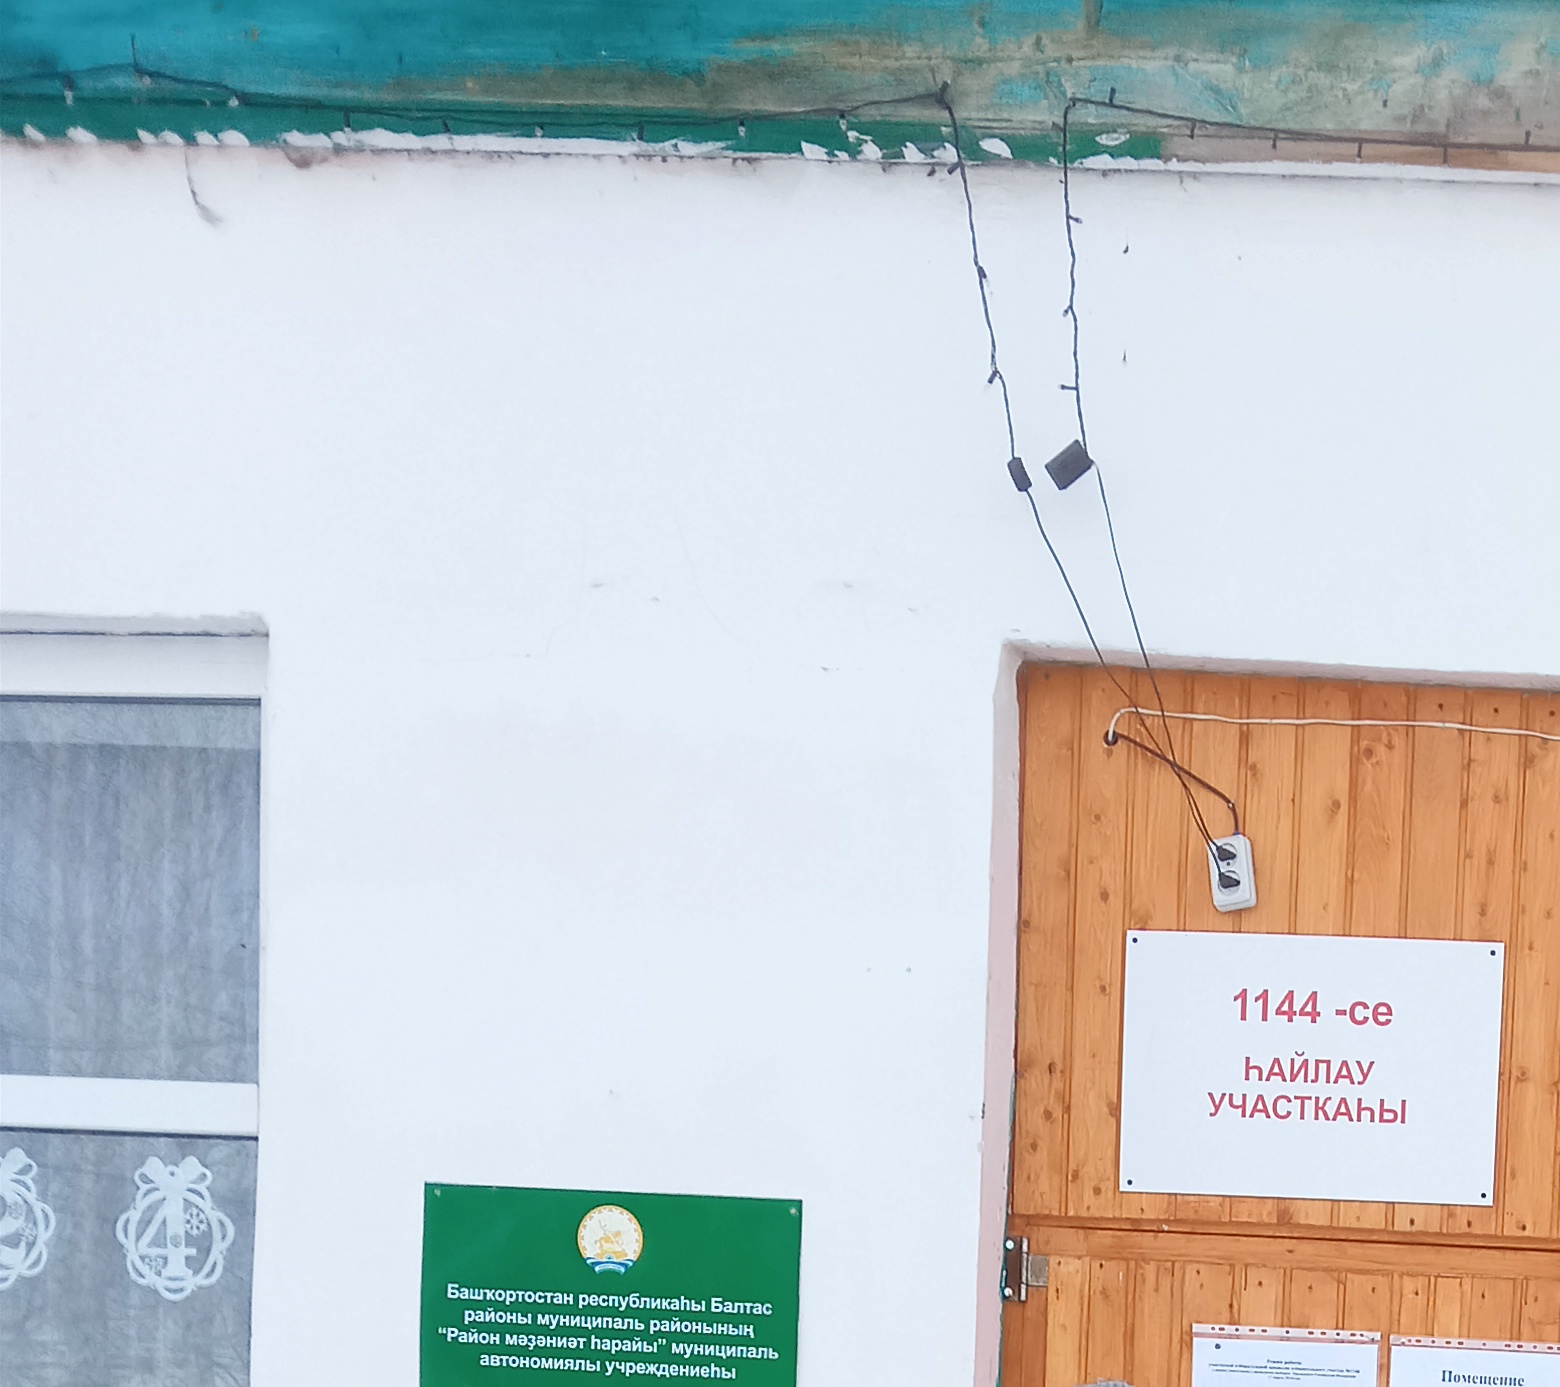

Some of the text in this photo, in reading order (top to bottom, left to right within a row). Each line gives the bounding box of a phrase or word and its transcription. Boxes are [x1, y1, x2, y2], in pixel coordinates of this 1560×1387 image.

[1232, 987, 1321, 1024] 1144
[710, 1297, 773, 1316] Балтас
[463, 1307, 532, 1325] районы
[537, 1313, 645, 1331] муниципаль
[671, 1341, 779, 1360] муниципаль
[479, 1353, 601, 1372] автономиялы
[1441, 1369, 1525, 1387] Помещение
